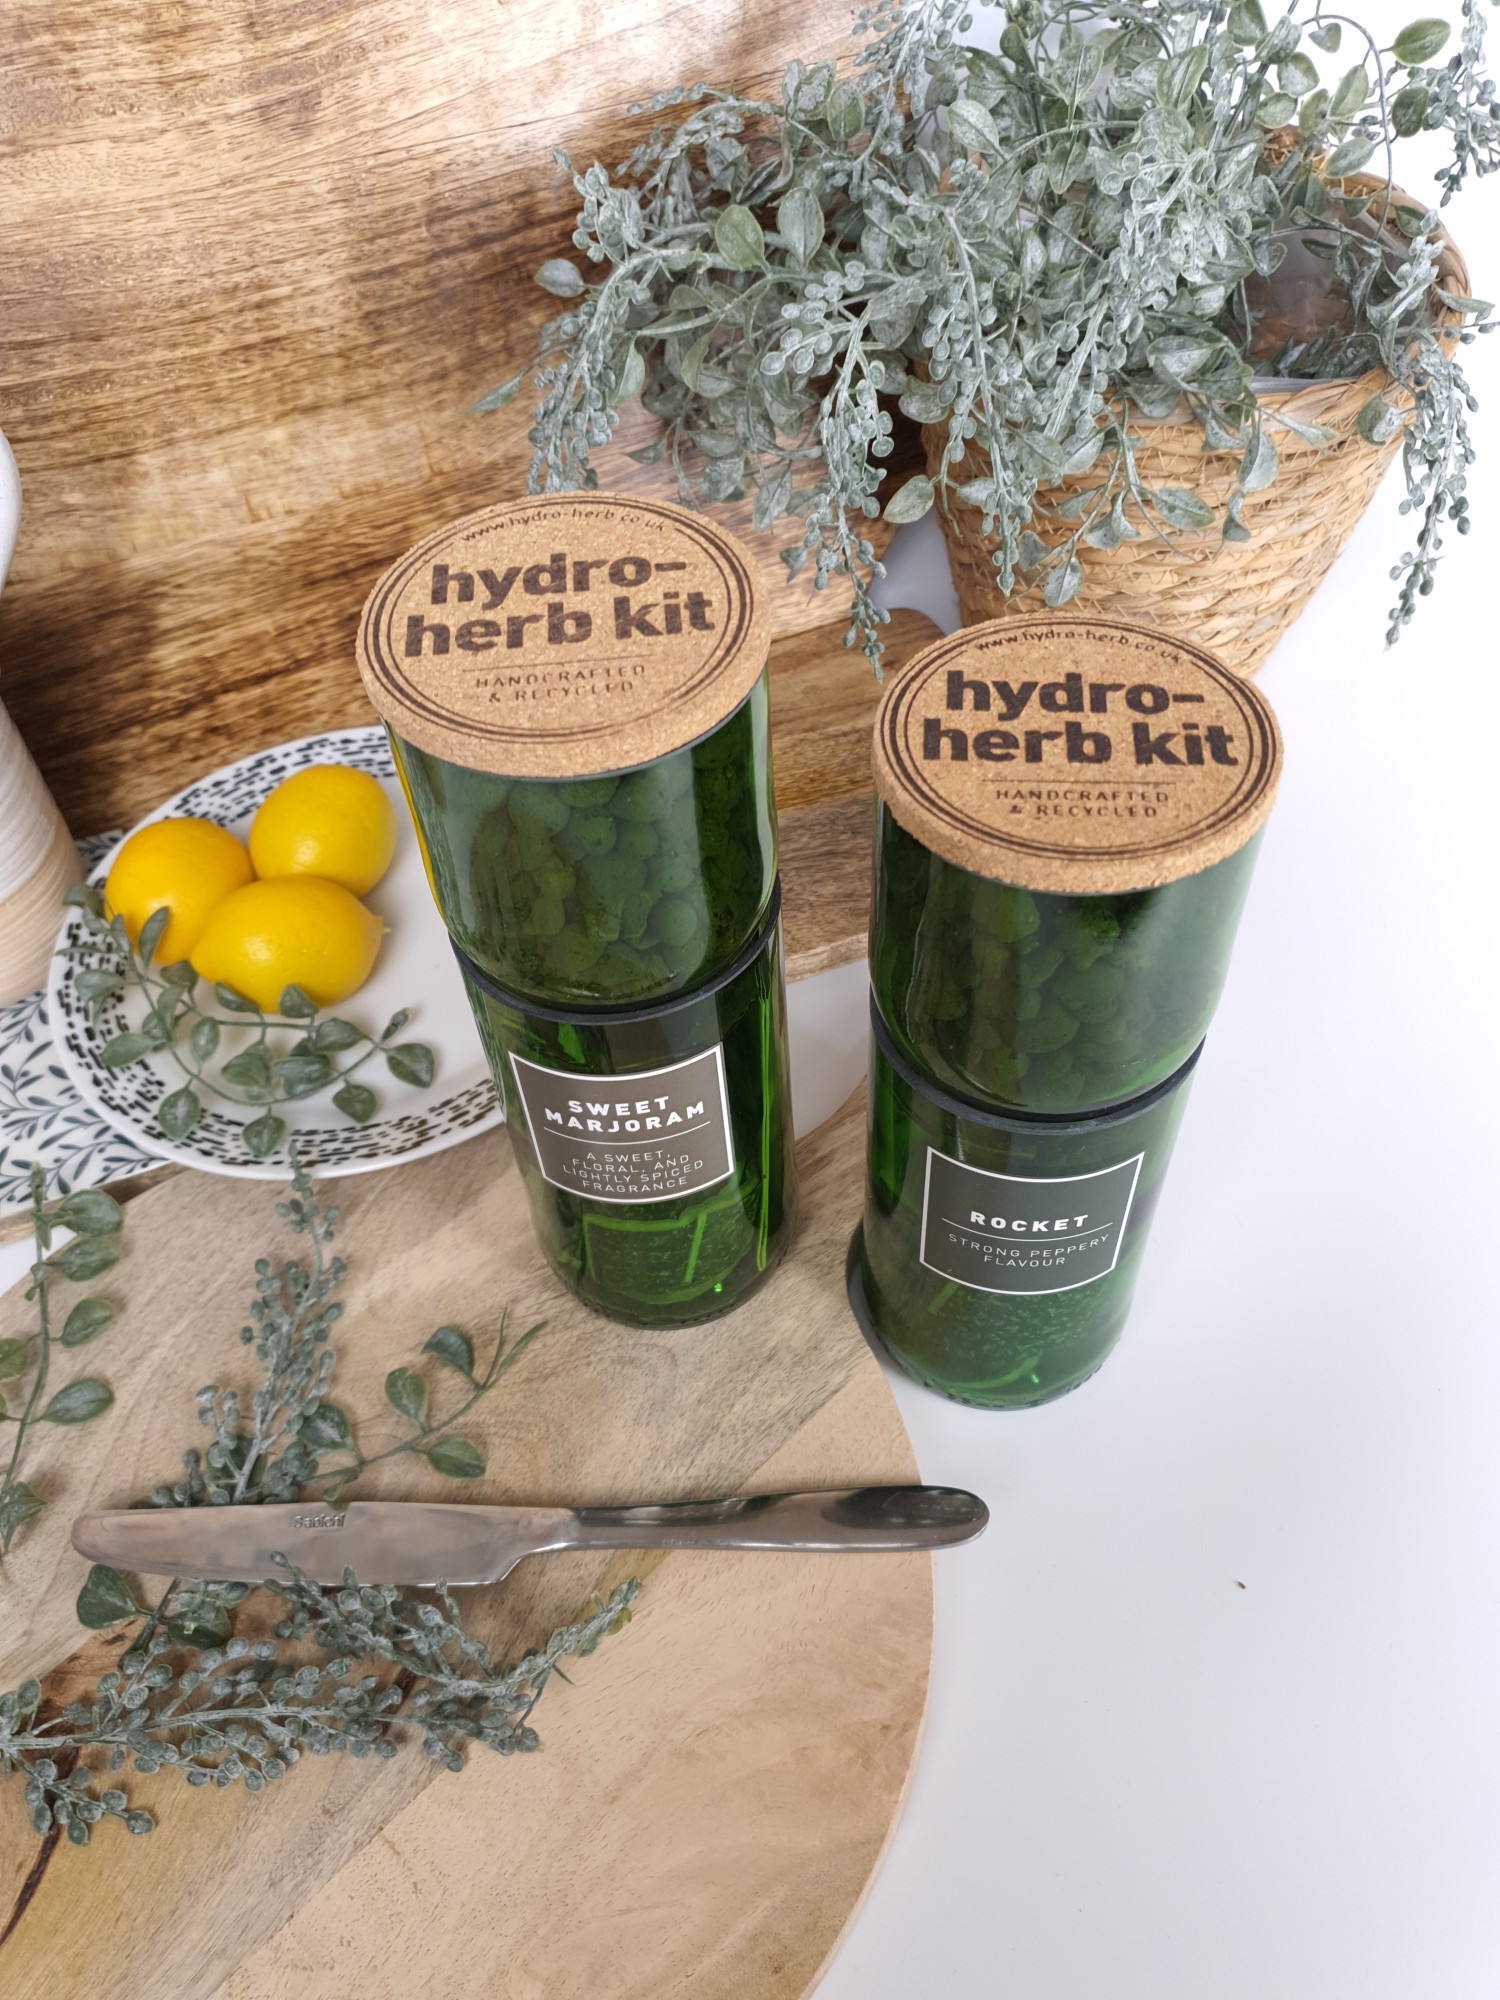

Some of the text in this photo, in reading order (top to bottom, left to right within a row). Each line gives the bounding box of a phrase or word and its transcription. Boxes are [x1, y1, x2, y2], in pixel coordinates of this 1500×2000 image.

[460, 507, 665, 542] www.hydro-herbcouk
[431, 552, 687, 611] hydro-
[404, 590, 715, 658] herb kit
[475, 664, 646, 688] HANDCRAFTED
[488, 680, 634, 704] & RECYCLED
[946, 670, 1205, 721] hydro-
[922, 718, 1239, 767] herb kit
[995, 789, 1169, 802] HANDCRAFTED
[1036, 804, 1158, 818] RECYCLED
[545, 1101, 704, 1133] MARJORAM
[568, 1096, 669, 1116] SWEET
[572, 1154, 689, 1173] FLORAL, AND
[587, 1150, 671, 1162] A SWEET,
[563, 1160, 703, 1183] LIGHTLY SPICED
[583, 1176, 688, 1193] FRAGRANCE
[970, 1210, 1089, 1232] ROCKET
[949, 1233, 1109, 1258] STRONG PEPPERY
[984, 1255, 1065, 1268] FLAVOUR
